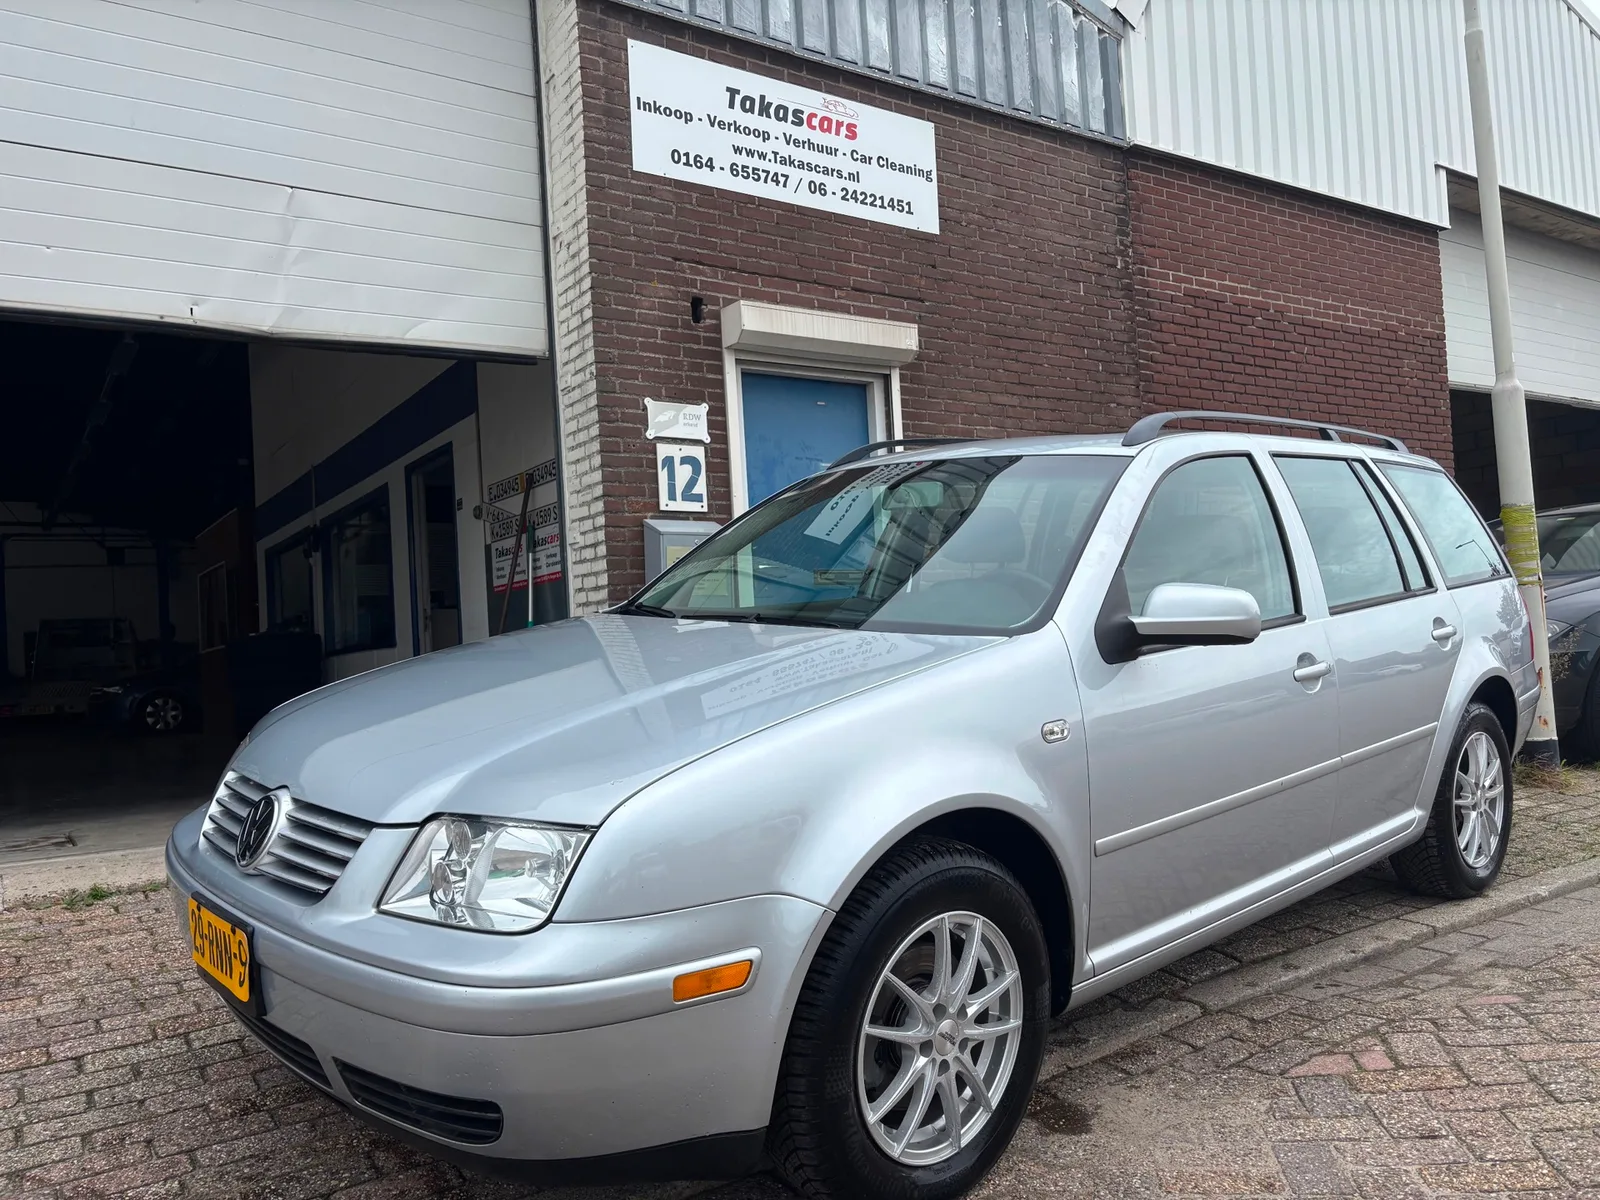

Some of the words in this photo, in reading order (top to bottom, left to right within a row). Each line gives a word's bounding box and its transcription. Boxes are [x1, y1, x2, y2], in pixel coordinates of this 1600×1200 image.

[725, 86, 858, 141] Takascars
[636, 96, 694, 124] Inkoop
[706, 114, 771, 143] Verkoop
[783, 132, 839, 158] Verhuur
[850, 150, 873, 166] Car
[876, 155, 933, 183] Cleaning
[732, 143, 860, 184] www.Takascars.nl
[670, 149, 715, 172] 0164
[729, 162, 789, 189] 655747
[794, 177, 803, 194] /
[808, 179, 827, 197] 06
[840, 187, 914, 216] 24221451
[683, 413, 702, 421] RDW
[661, 455, 704, 503] 12
[532, 532, 560, 549] akascars
[191, 908, 248, 988] 29-RNN-9
